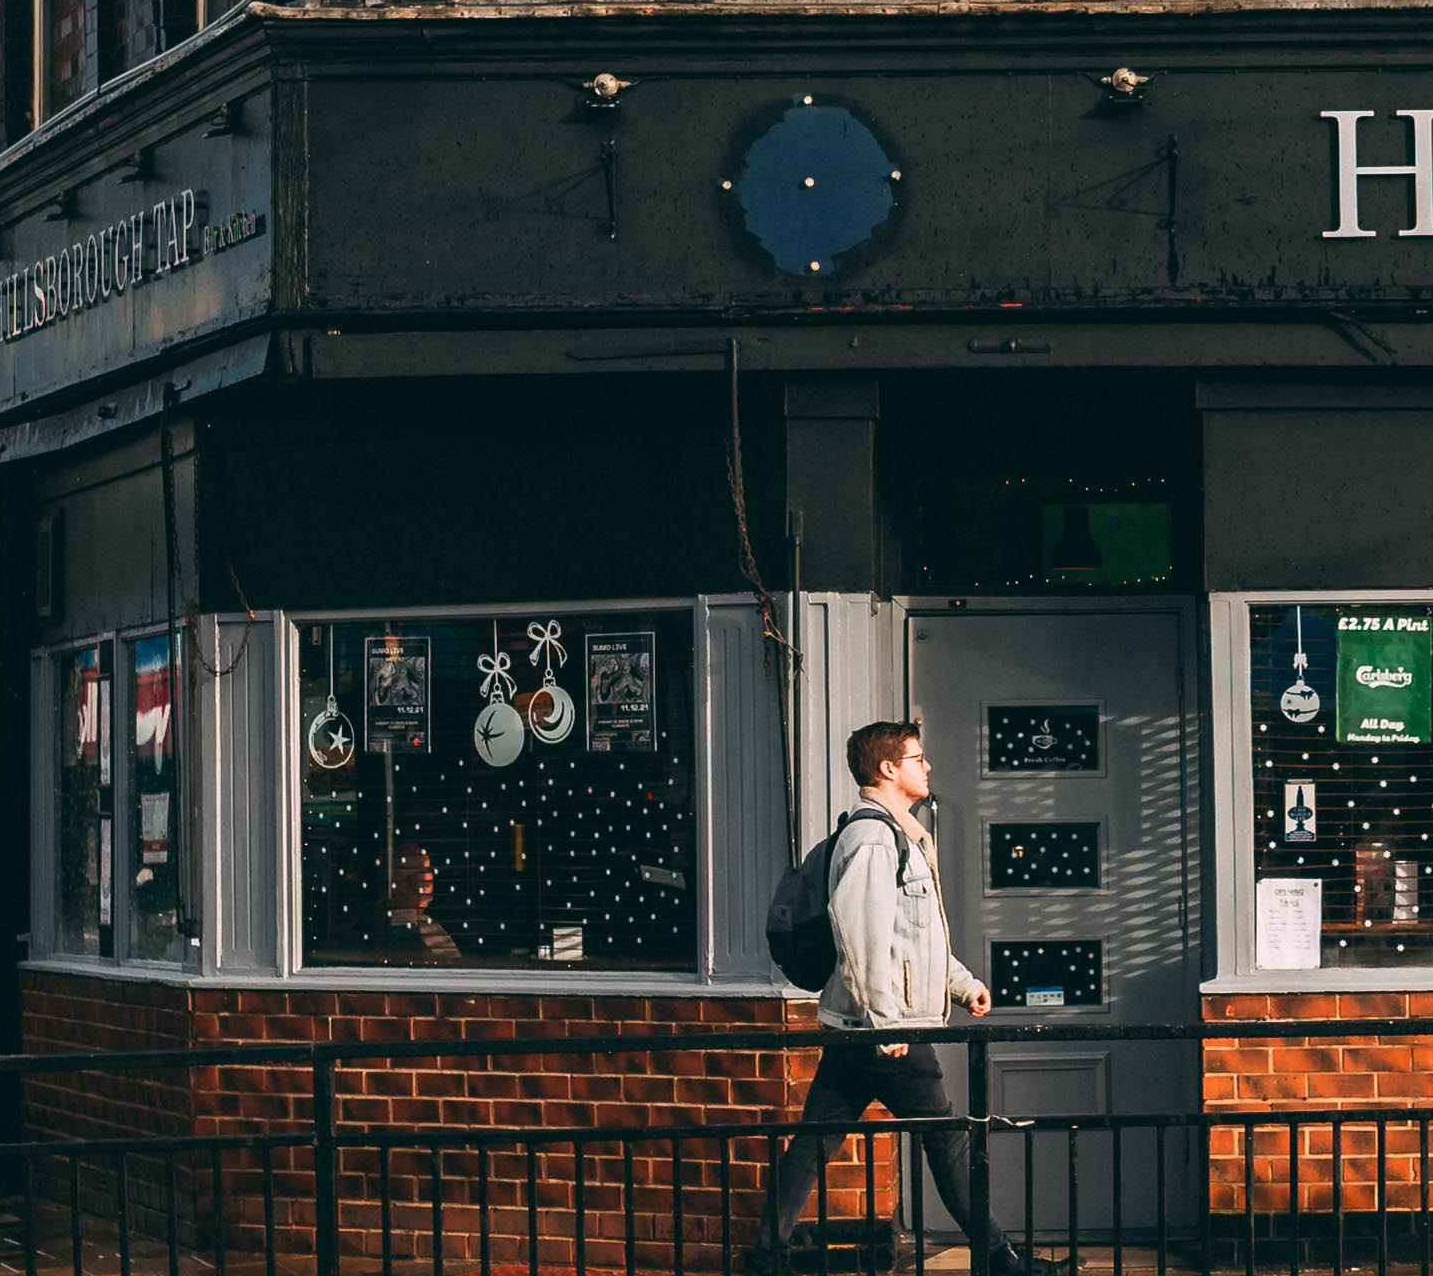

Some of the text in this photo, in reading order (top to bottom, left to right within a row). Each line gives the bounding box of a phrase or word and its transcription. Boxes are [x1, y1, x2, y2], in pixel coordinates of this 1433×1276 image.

[153, 188, 195, 274] TAP
[1338, 617, 1429, 631] £2.75 A Pint
[1356, 666, 1412, 688] Carlsberg
[1360, 718, 1405, 731] All Day
[1347, 733, 1420, 744] Monday to Friday
